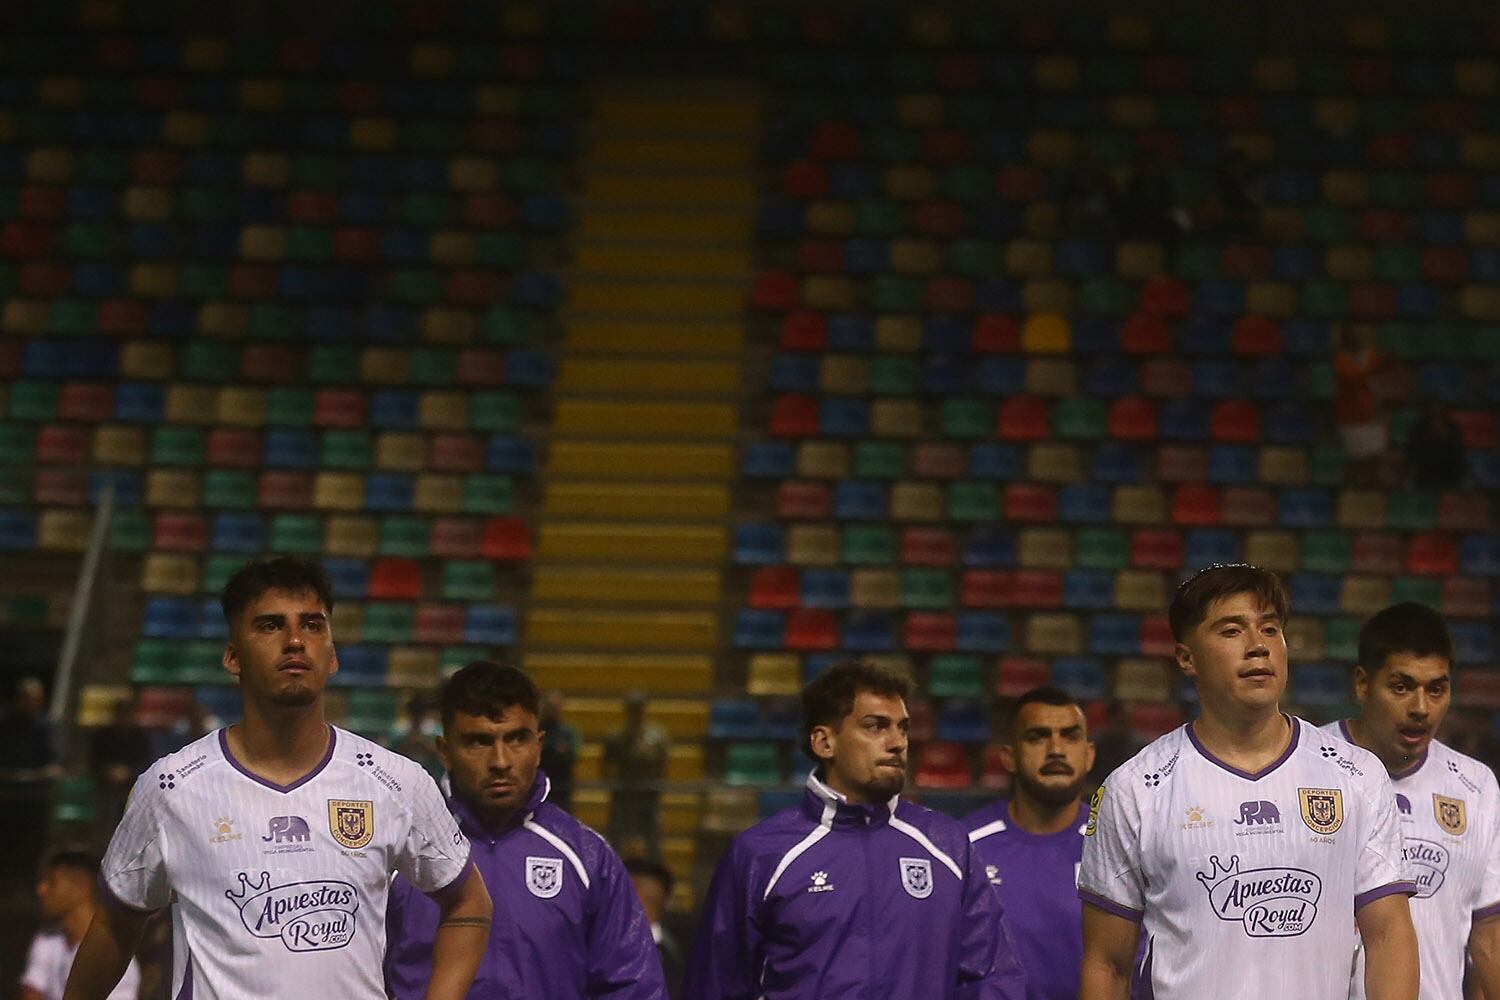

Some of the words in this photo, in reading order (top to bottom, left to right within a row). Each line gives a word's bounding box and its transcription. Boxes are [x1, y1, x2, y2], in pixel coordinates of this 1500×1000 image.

[255, 886, 353, 931] Apuestas
[1221, 872, 1314, 913] Apuestas
[289, 913, 348, 947] Royal
[1249, 902, 1307, 933] Royal
